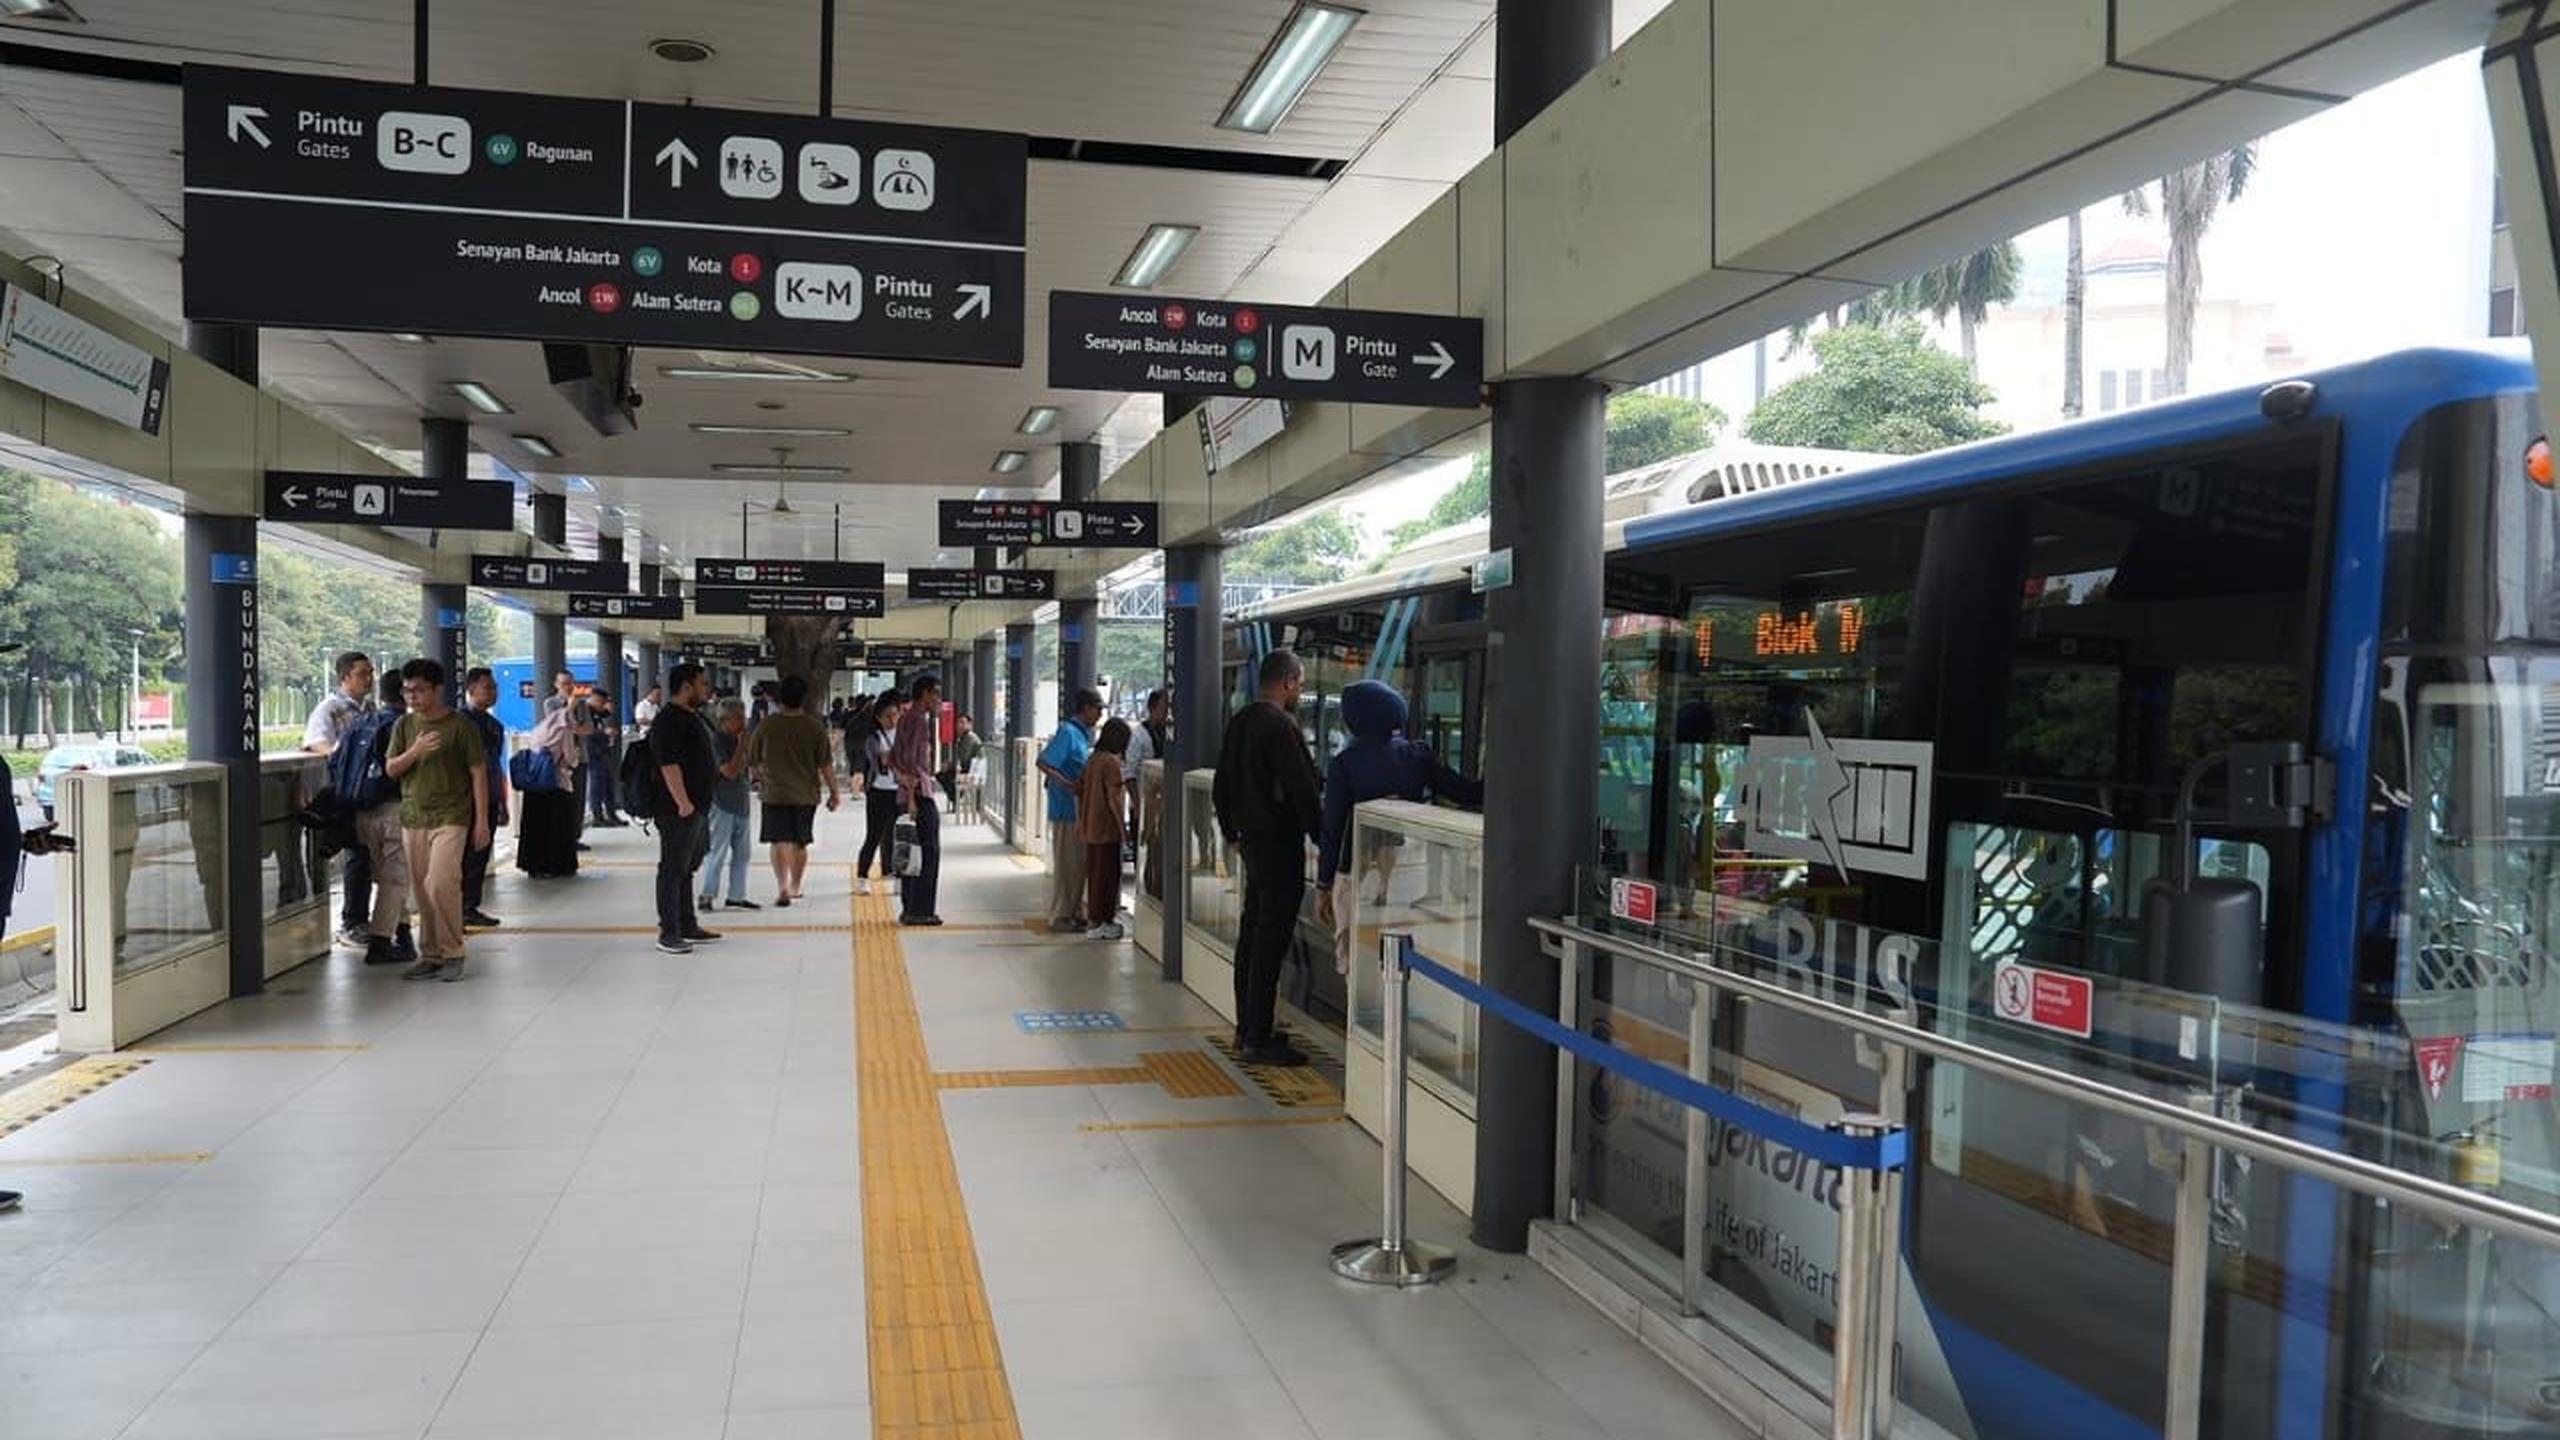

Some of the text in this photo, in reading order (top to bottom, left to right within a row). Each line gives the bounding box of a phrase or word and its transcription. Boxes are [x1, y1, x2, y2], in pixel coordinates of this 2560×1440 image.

[298, 110, 363, 138] Pintu
[297, 138, 351, 160] Gates
[394, 127, 456, 159] B~C
[527, 142, 594, 164] Ragunan
[457, 239, 521, 263] Senayan
[525, 243, 563, 264] Bank
[565, 246, 620, 268] Jakarta
[688, 256, 722, 274] Kota
[538, 285, 582, 306] Ancol
[785, 276, 852, 307] K~M
[875, 275, 933, 300] Pintu
[631, 290, 671, 309] Alam
[673, 293, 722, 313] Sutera
[885, 302, 933, 321] Gates
[1120, 306, 1158, 326] Ancol
[1197, 310, 1227, 328] Kota
[1084, 333, 1142, 355] Senayan
[1144, 336, 1178, 354] Bank
[1179, 339, 1228, 358] Jakarta
[1295, 337, 1323, 368] M
[1345, 335, 1397, 357] Pintu
[1146, 363, 1181, 381] Alam
[1183, 366, 1227, 383] Sutera
[1362, 360, 1397, 379] Gate
[361, 492, 376, 509] A
[1063, 516, 1074, 532] L
[1756, 611, 1821, 655] Blok
[242, 590, 255, 751] BUNDARAN
[1744, 1222, 1767, 1259] of
[1771, 1231, 1840, 1309] Jakart
